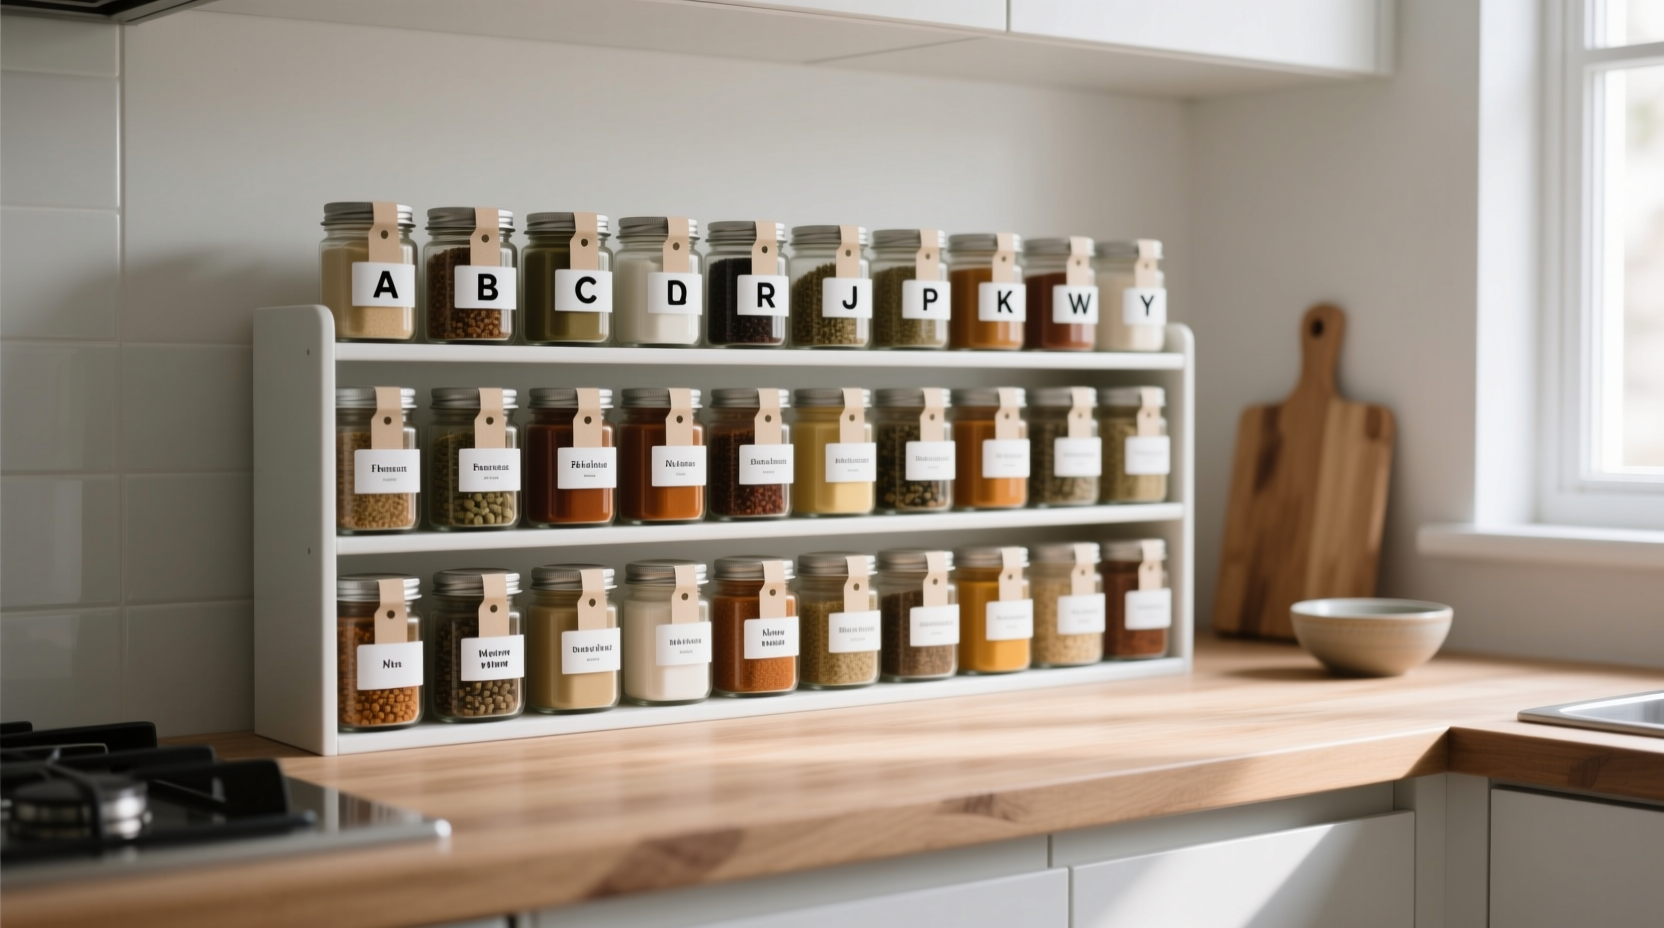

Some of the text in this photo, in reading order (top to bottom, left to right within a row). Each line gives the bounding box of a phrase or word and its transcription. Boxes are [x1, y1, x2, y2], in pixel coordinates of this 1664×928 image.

[372, 270, 399, 299] A
[477, 273, 499, 302] B
[574, 275, 598, 305] C
[667, 279, 688, 306] D
[757, 281, 776, 309] R
[842, 285, 858, 310] J
[922, 287, 940, 311] P
[997, 290, 1014, 314] K
[1068, 292, 1091, 316] W
[1140, 294, 1155, 317] Y
